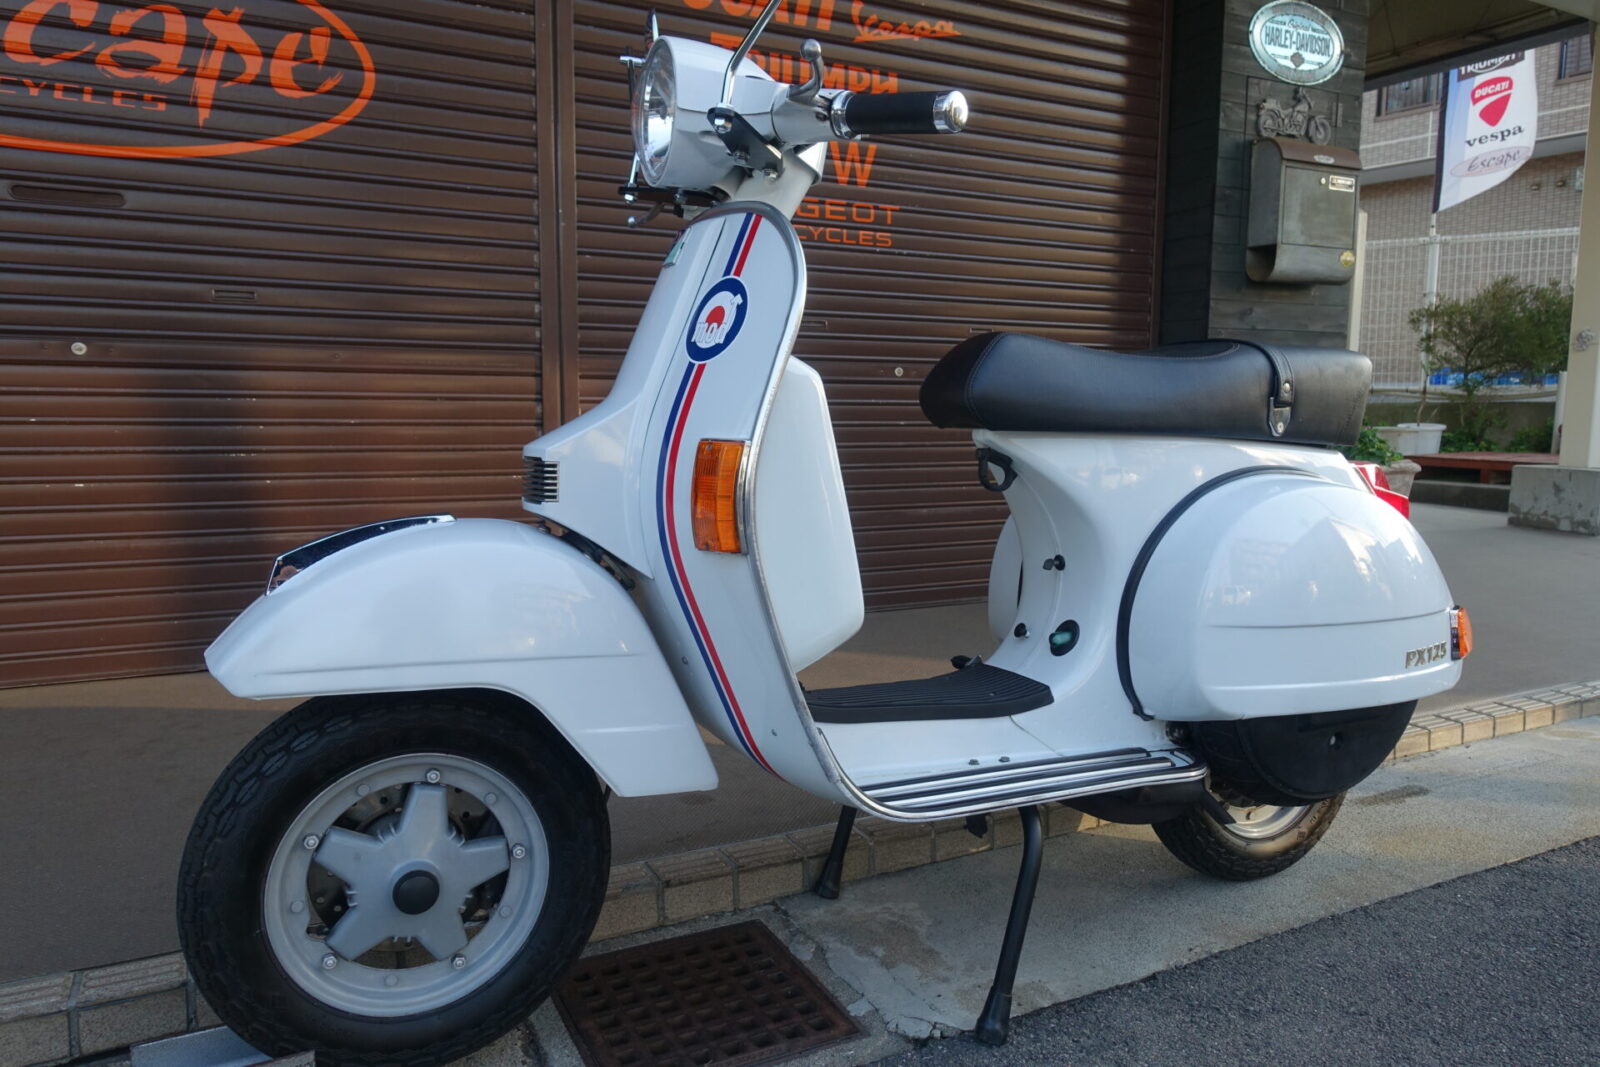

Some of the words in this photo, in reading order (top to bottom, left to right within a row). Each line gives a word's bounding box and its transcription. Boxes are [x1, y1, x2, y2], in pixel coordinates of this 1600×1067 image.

[851, 0, 961, 43] Vespa
[1264, 24, 1332, 58] HARLEY-DAVIDSON
[1473, 80, 1510, 100] DUCATI
[1465, 125, 1525, 148] vespa
[1467, 150, 1521, 172] Escape
[1405, 640, 1448, 669] PX125
